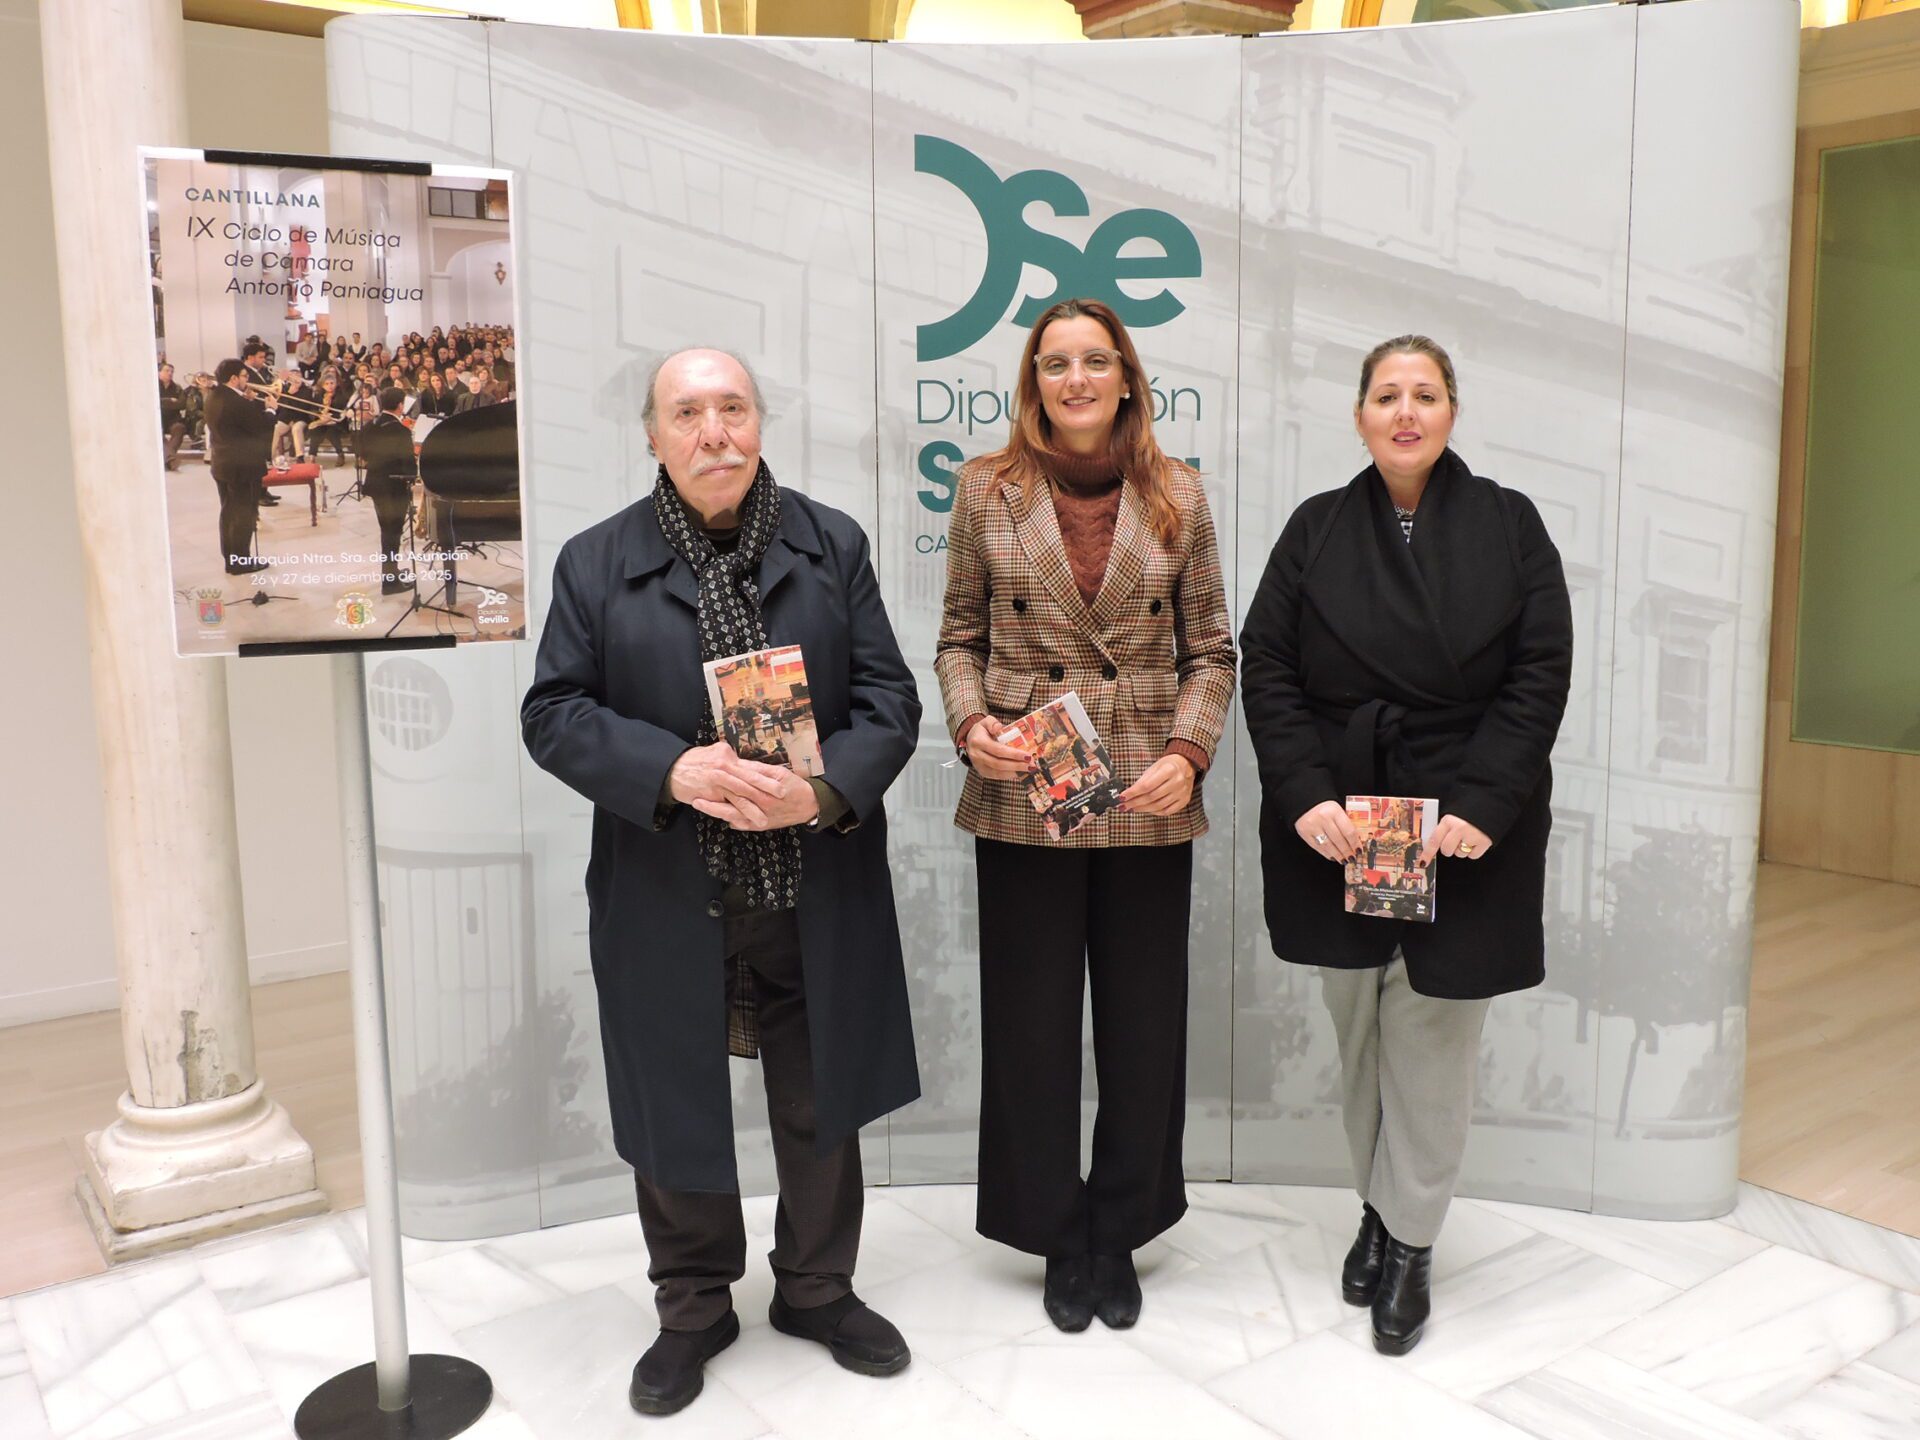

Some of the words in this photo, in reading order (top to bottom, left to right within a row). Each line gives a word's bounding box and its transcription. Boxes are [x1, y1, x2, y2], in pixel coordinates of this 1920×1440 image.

[185, 187, 320, 208] CANTILLANA
[187, 216, 216, 238] IX
[223, 222, 281, 241] Ciclo
[289, 225, 317, 243] de
[324, 227, 401, 248] Música
[224, 250, 254, 267] de
[261, 251, 353, 271] Cámara
[225, 277, 313, 297] Antonio
[320, 280, 424, 304] Paniagua
[229, 554, 299, 567] Parroquia
[303, 553, 337, 563] Ntra.
[340, 552, 366, 563] Sra.
[369, 551, 388, 562] de
[390, 550, 405, 562] la
[407, 548, 469, 561] Asunción
[250, 574, 266, 585] 26
[270, 576, 279, 587] y
[282, 573, 298, 585] 27
[302, 573, 321, 584] de
[324, 570, 396, 584] diciembre
[398, 570, 418, 582] de
[420, 569, 453, 582] 2025
[478, 614, 510, 625] Sevilla
